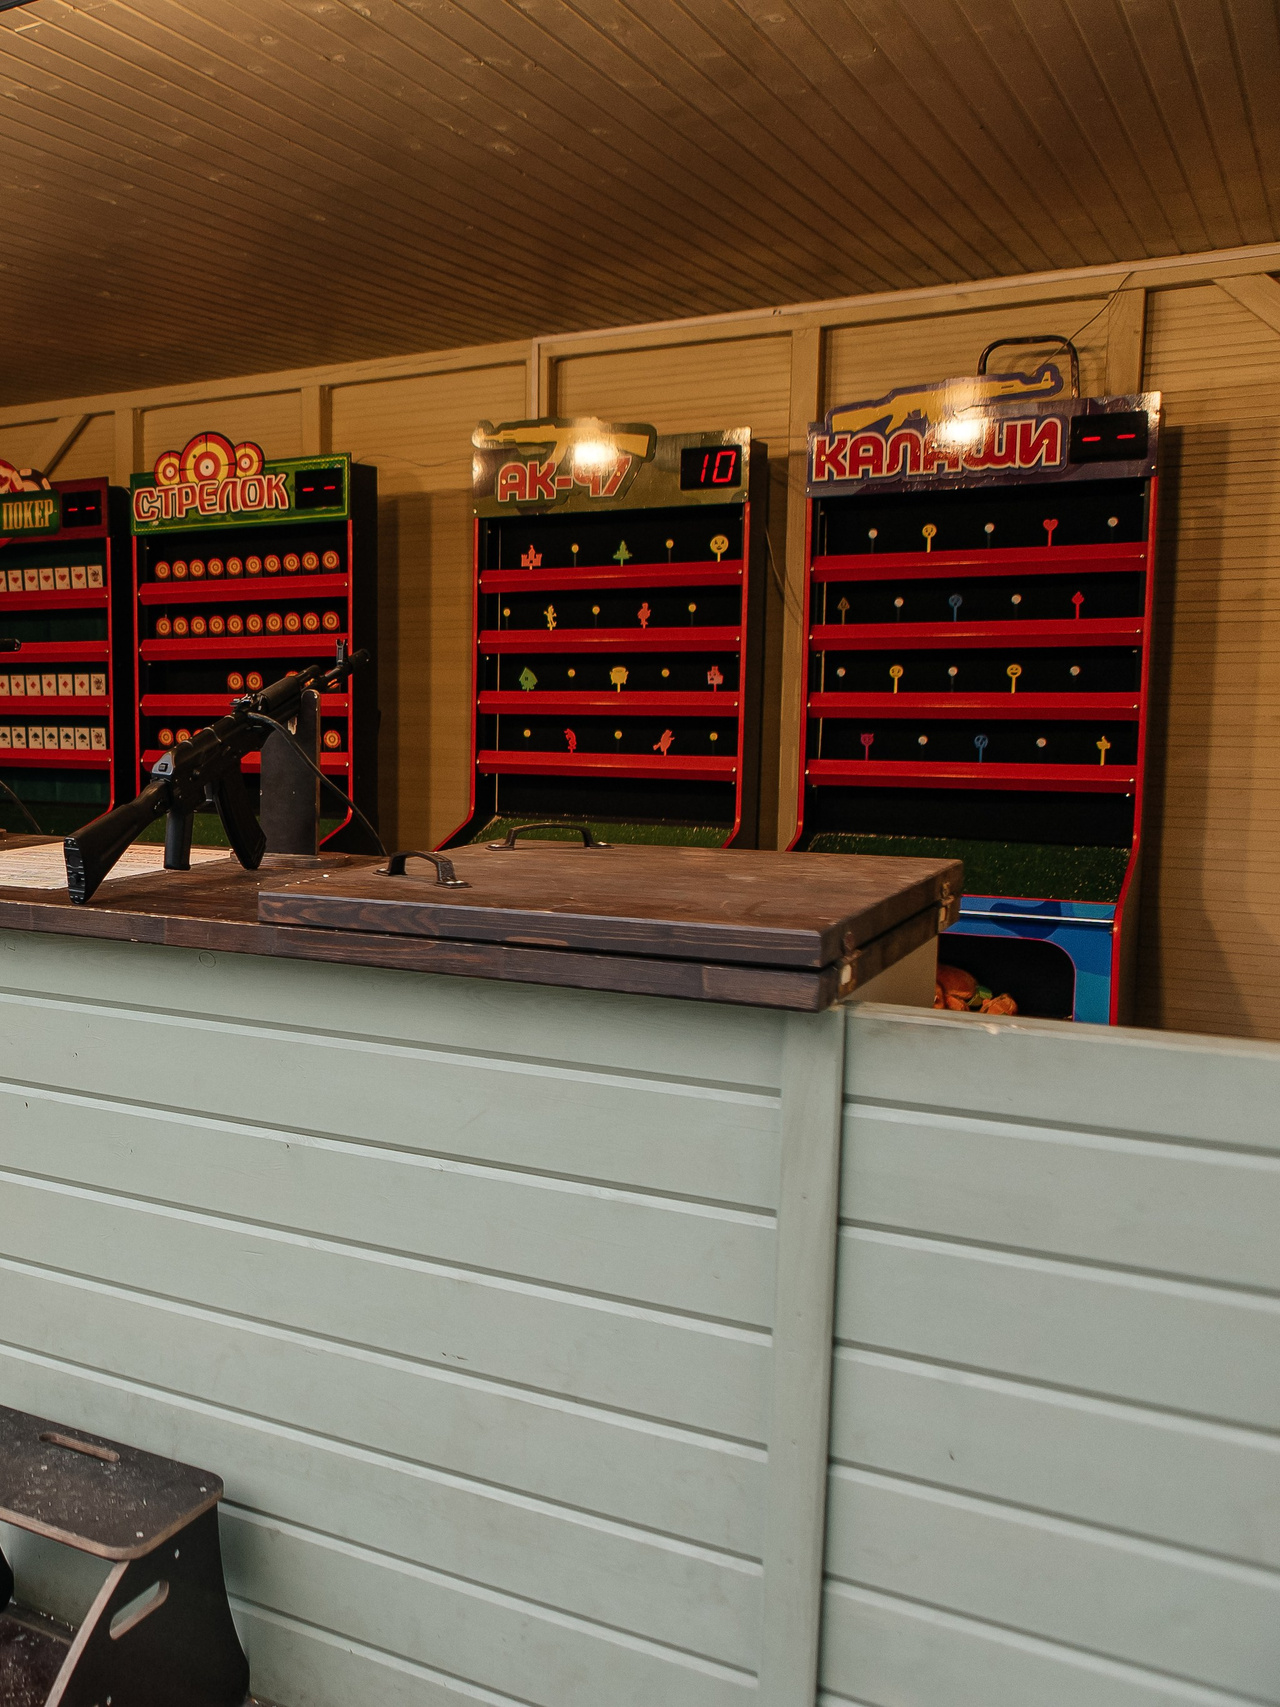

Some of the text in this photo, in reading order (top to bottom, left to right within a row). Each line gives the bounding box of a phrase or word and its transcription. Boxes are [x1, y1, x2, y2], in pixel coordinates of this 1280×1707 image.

[700, 450, 737, 484] 10
[133, 473, 289, 522] СТРЕЛОК
[2, 499, 54, 531] ПОКЕР
